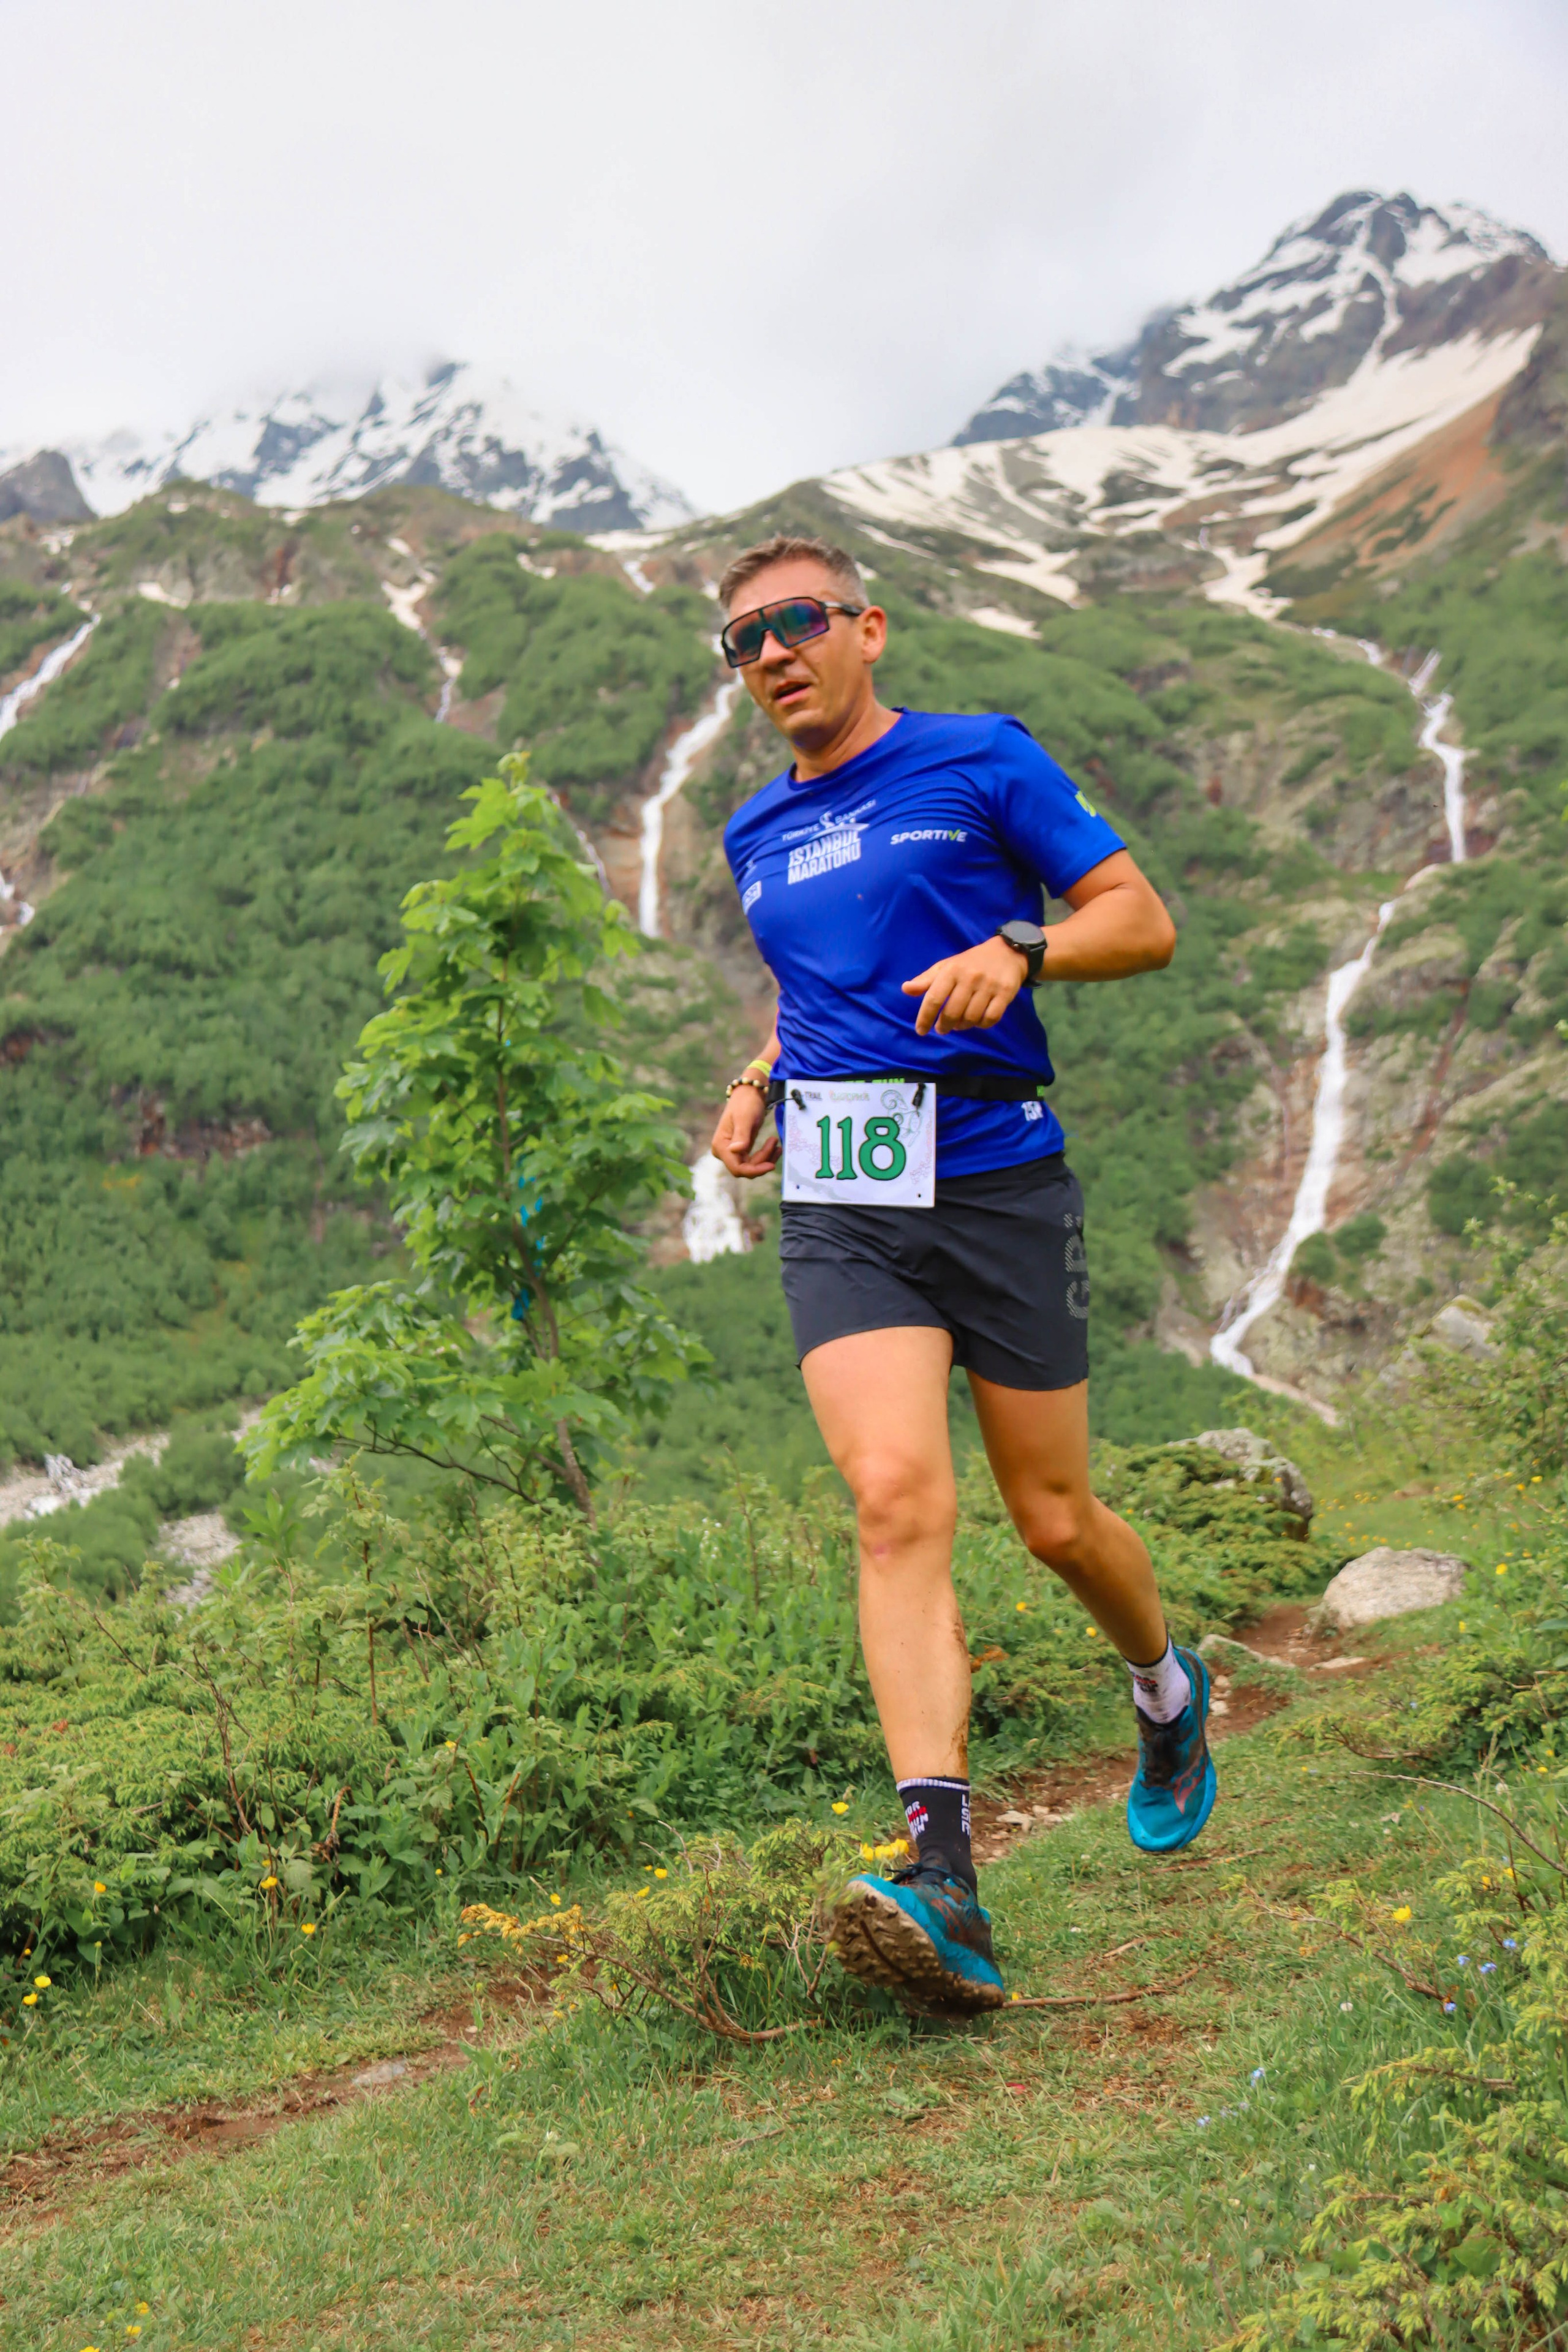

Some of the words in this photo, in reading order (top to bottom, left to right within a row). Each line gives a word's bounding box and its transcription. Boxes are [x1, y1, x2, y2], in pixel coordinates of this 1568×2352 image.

[890, 829, 968, 845] SPORTIVE
[788, 842, 861, 885] MARATONU
[815, 1115, 907, 1181] 118
